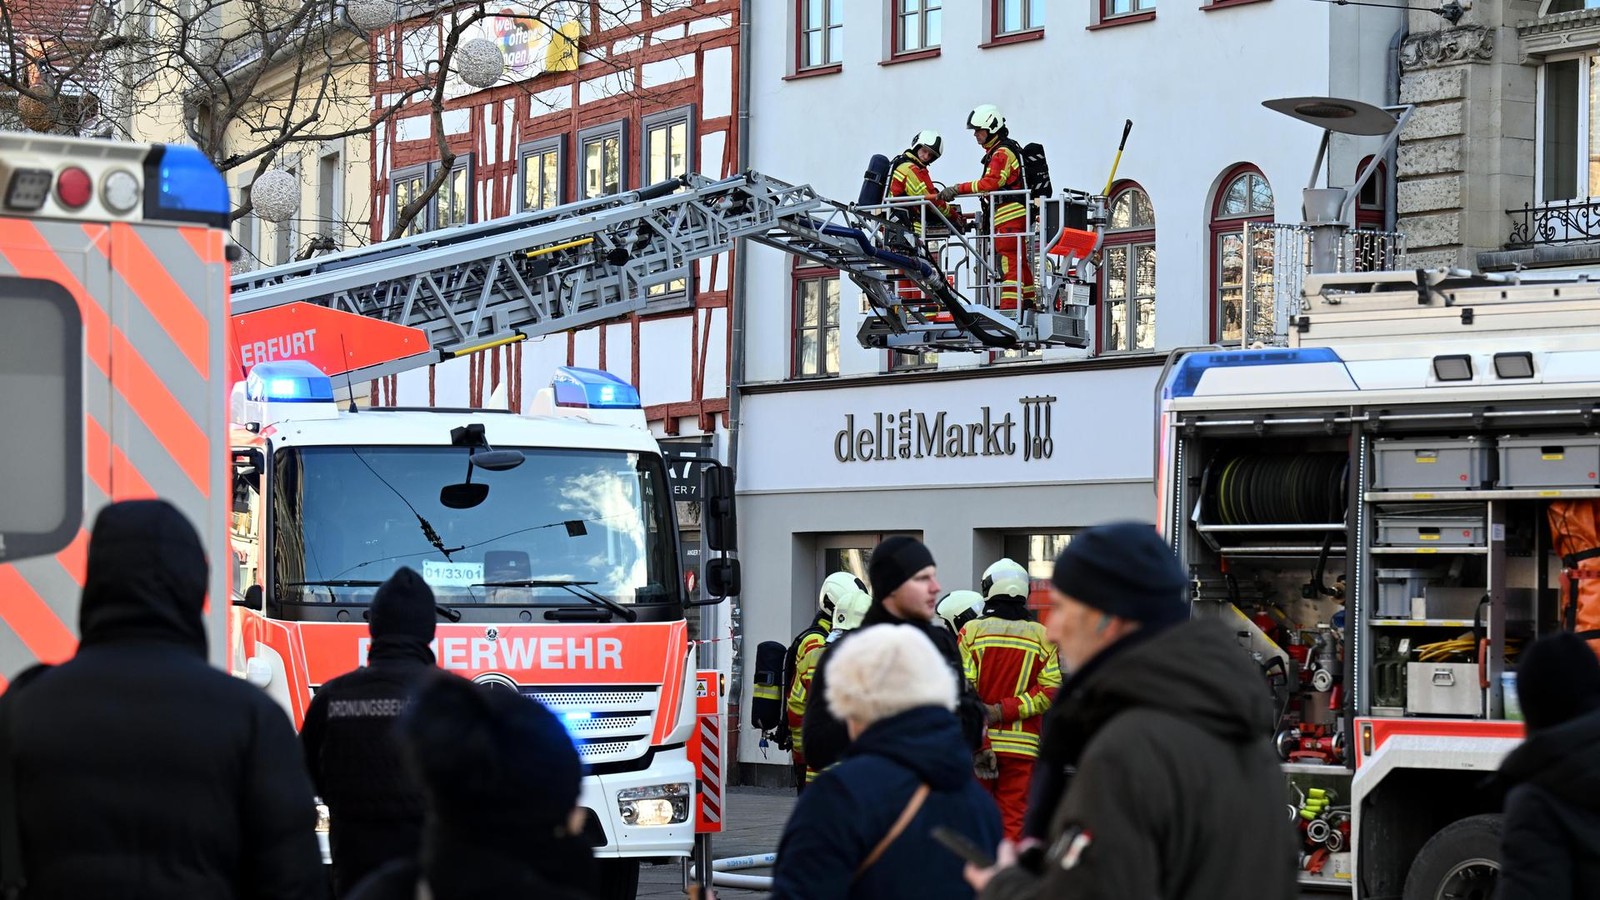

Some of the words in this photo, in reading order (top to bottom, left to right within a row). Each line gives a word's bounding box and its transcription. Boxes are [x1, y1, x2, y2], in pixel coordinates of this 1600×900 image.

[241, 328, 317, 367] ERFURT
[834, 411, 897, 462] deli
[899, 408, 912, 459] am
[914, 406, 1016, 458] Markt
[690, 486, 697, 494] 7
[425, 567, 481, 580] 01/33/01
[357, 637, 623, 670] FERWEHR
